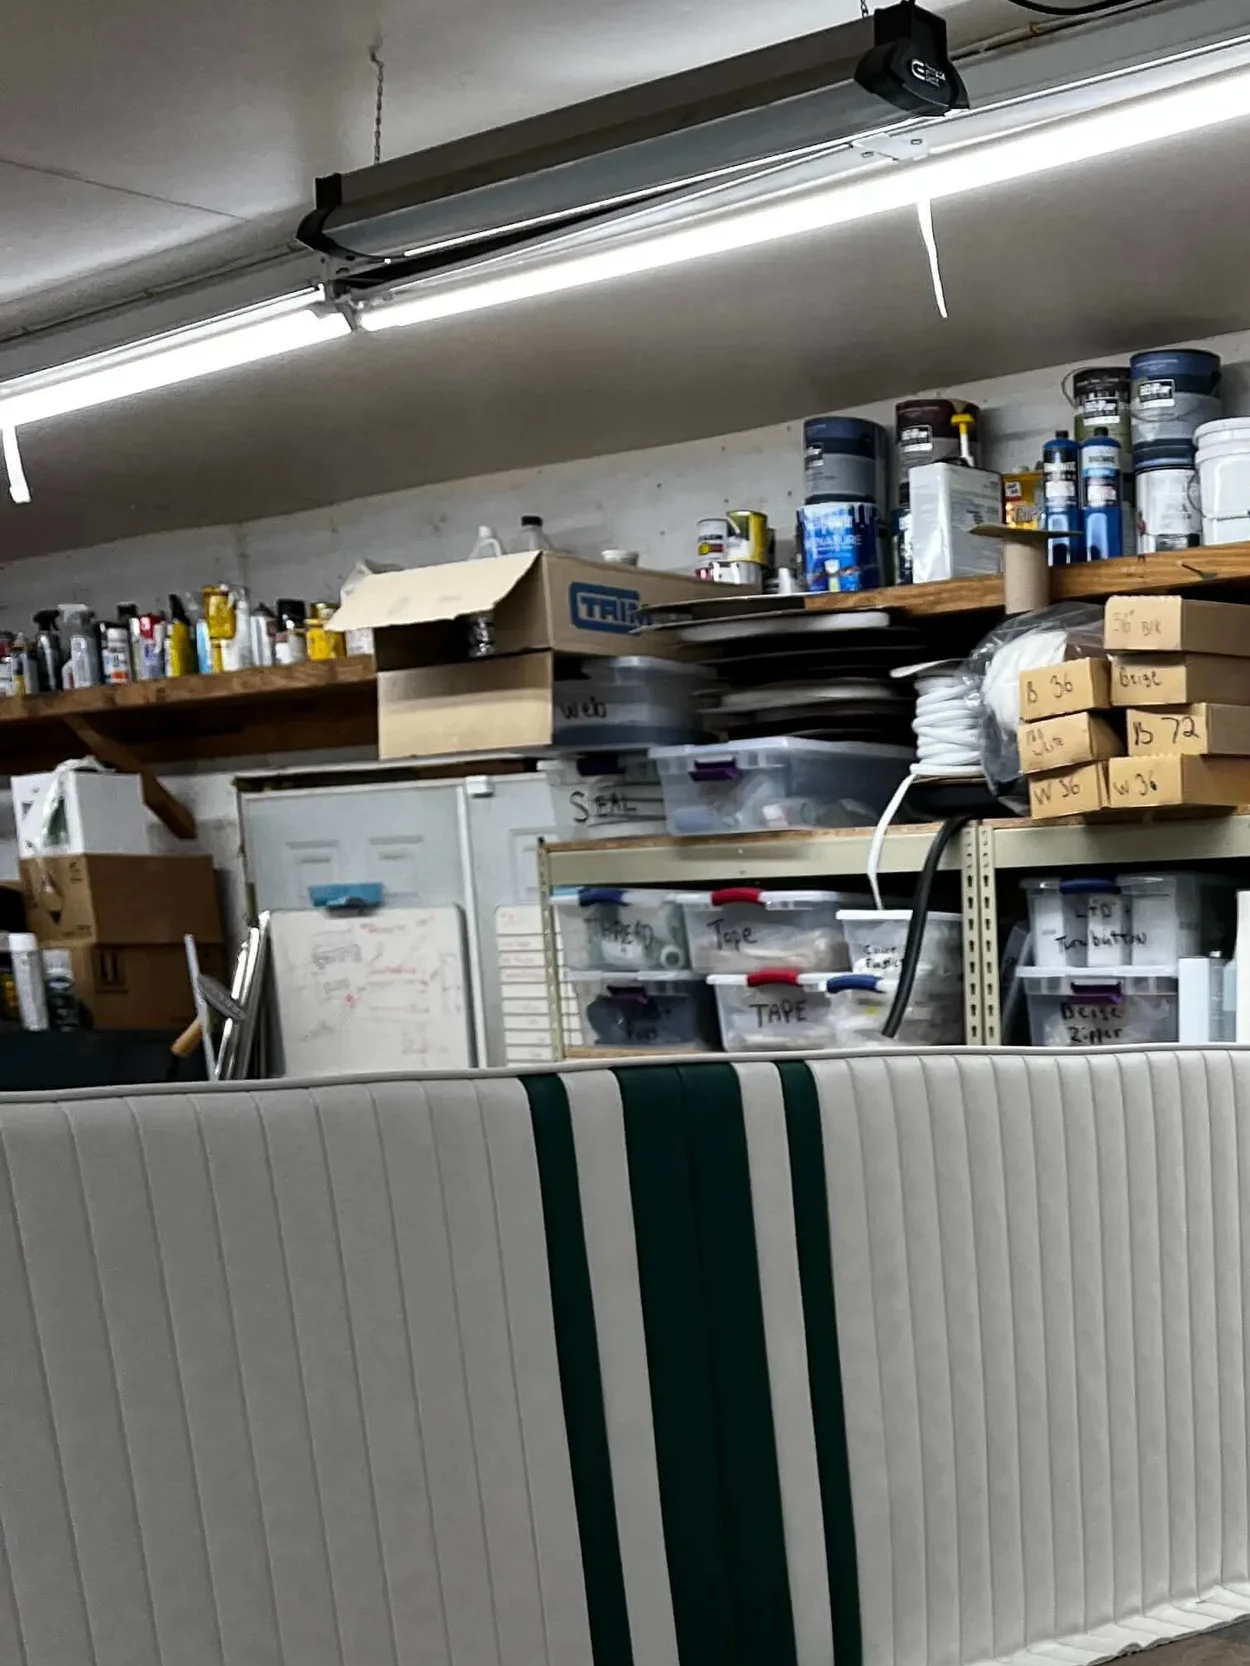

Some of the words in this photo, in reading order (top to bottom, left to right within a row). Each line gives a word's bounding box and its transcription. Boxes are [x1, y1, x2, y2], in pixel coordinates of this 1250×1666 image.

[1050, 672, 1073, 699] 36
[1133, 721, 1153, 746] B
[1161, 716, 1200, 744] 72
[1033, 785, 1051, 805] W
[1059, 777, 1080, 798] 36
[1136, 773, 1158, 796] 36
[569, 791, 637, 823] SEAL
[706, 918, 759, 951] Tape
[749, 998, 807, 1028] TAPE
